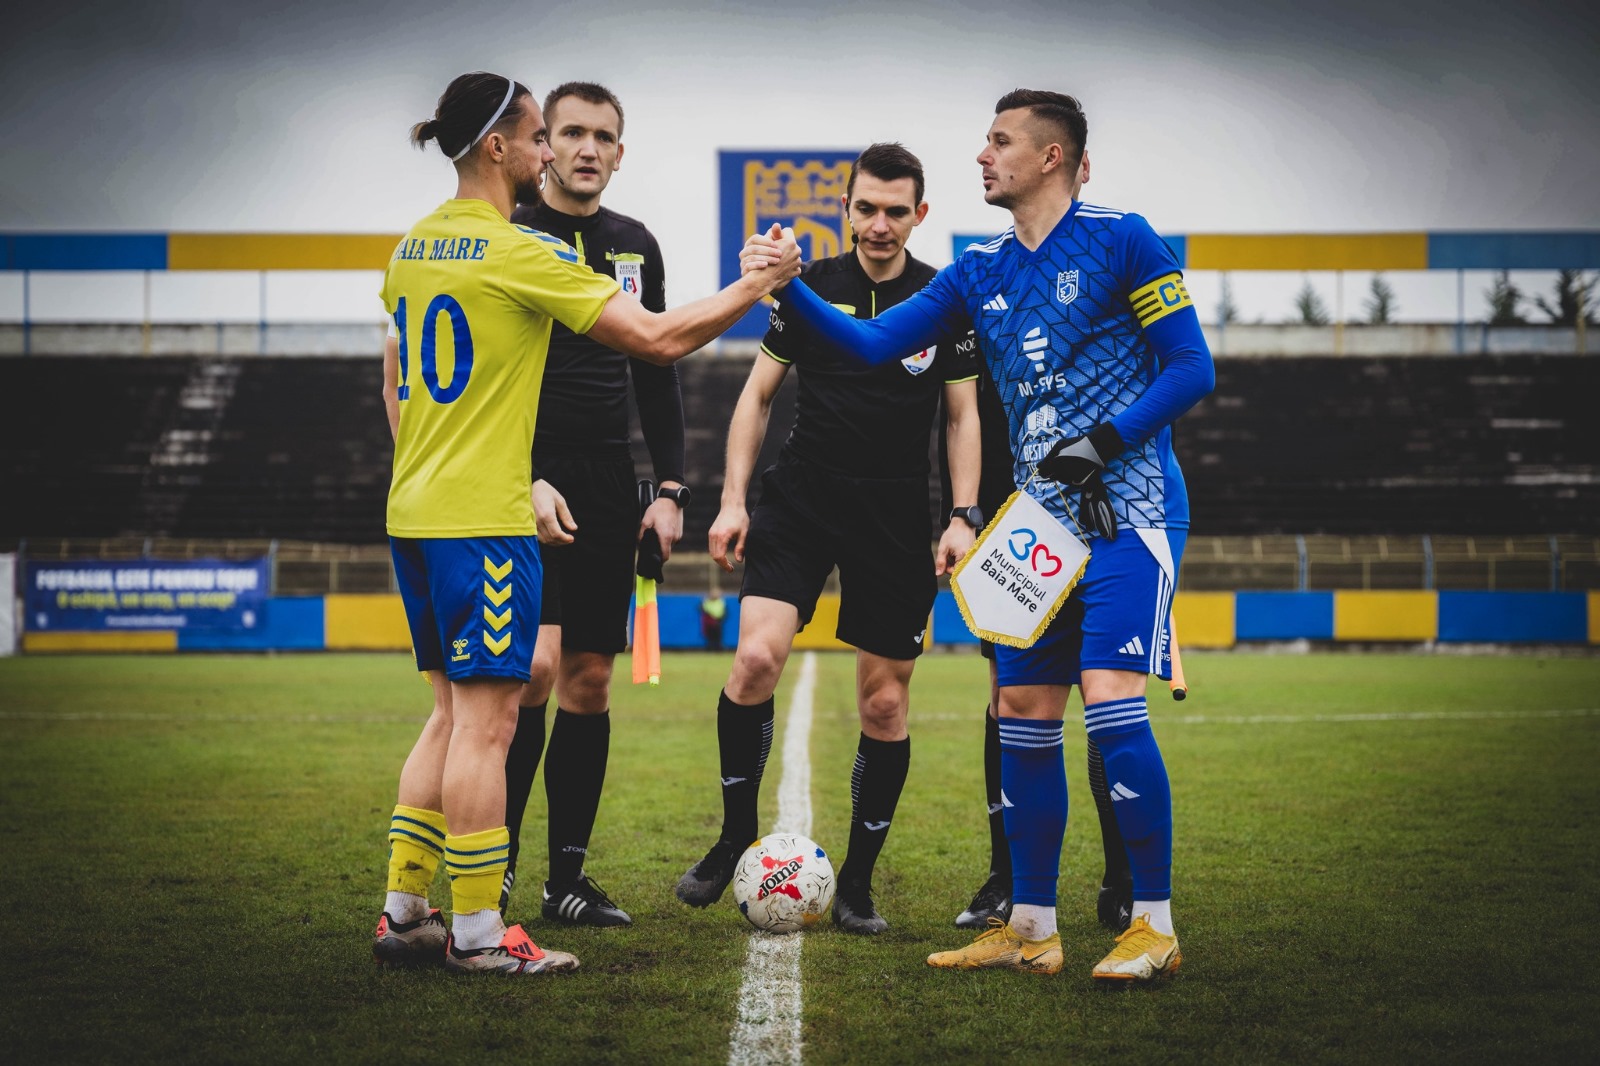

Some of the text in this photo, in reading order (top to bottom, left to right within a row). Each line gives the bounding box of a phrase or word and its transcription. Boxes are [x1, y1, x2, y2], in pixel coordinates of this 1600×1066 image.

[429, 238, 489, 260] MARE
[1159, 282, 1181, 307] C
[393, 293, 474, 404] 10
[1023, 443, 1042, 462] BEST
[980, 558, 1038, 613] Baia Mare
[990, 548, 1047, 601] Municipiul
